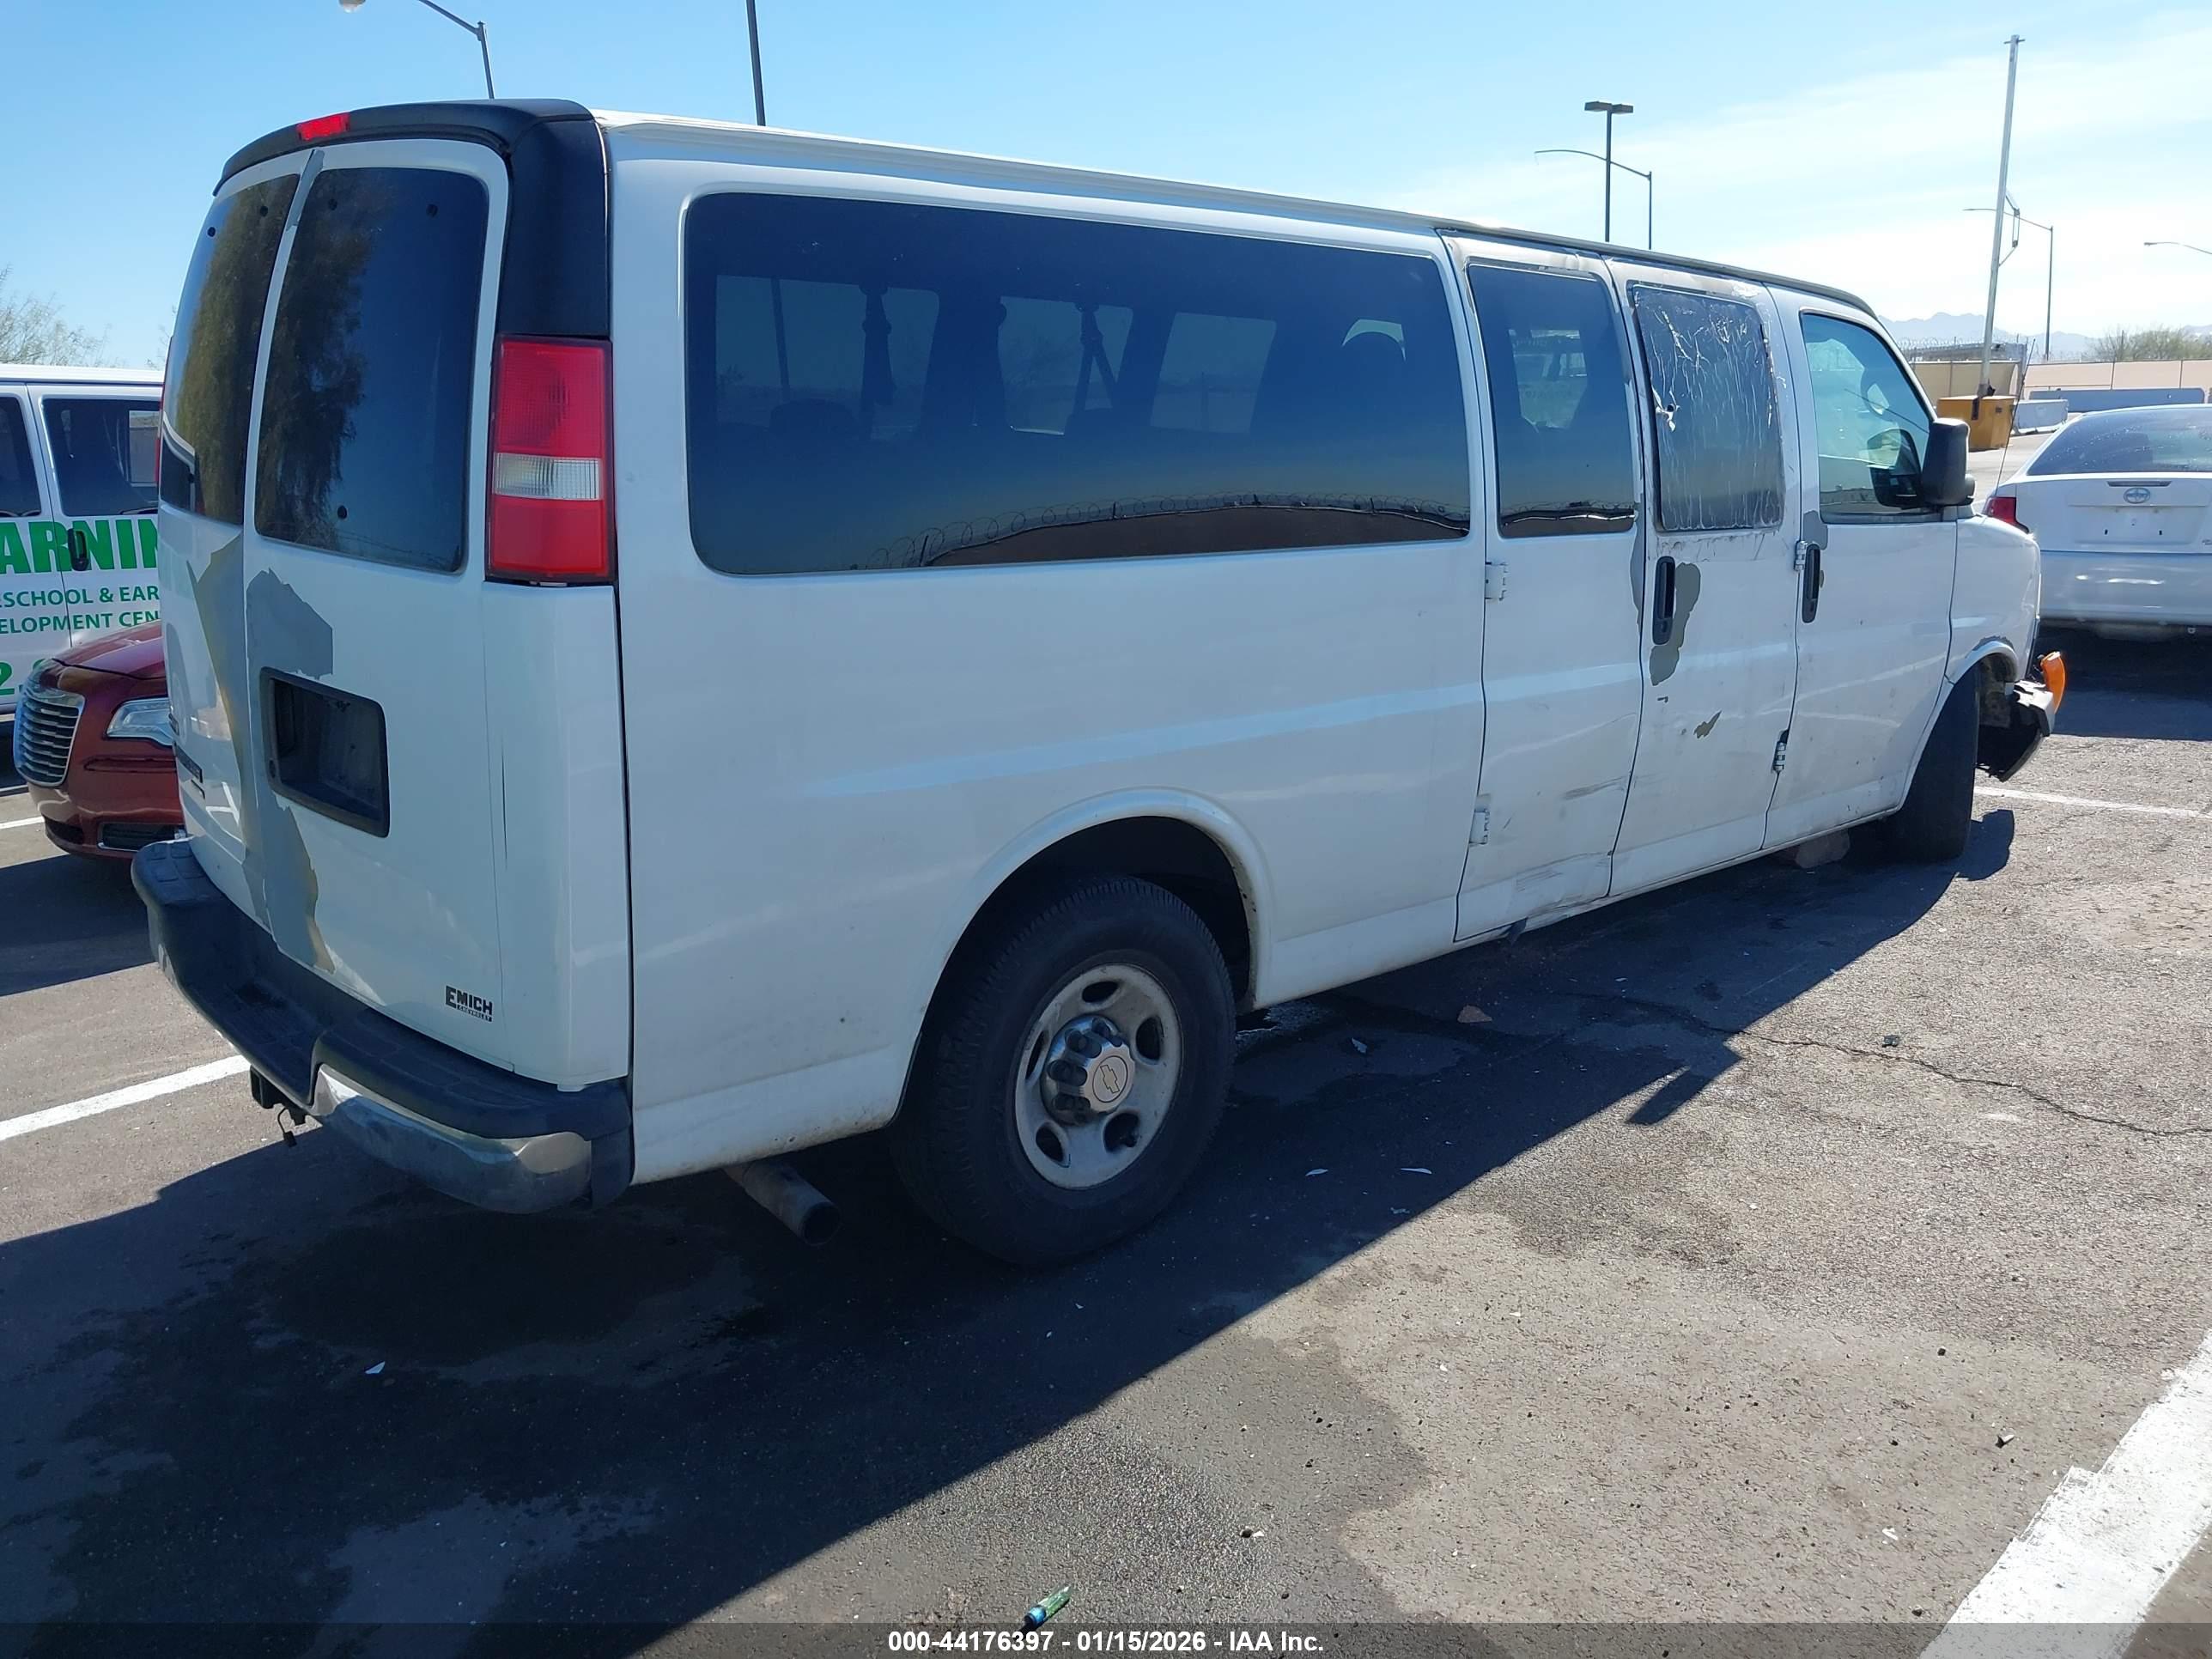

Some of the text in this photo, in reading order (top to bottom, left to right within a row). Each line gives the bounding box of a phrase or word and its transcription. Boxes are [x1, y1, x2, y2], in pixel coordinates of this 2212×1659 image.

[0, 586, 160, 608] SCHOOL & EAR
[446, 985, 493, 1015] EMICH
